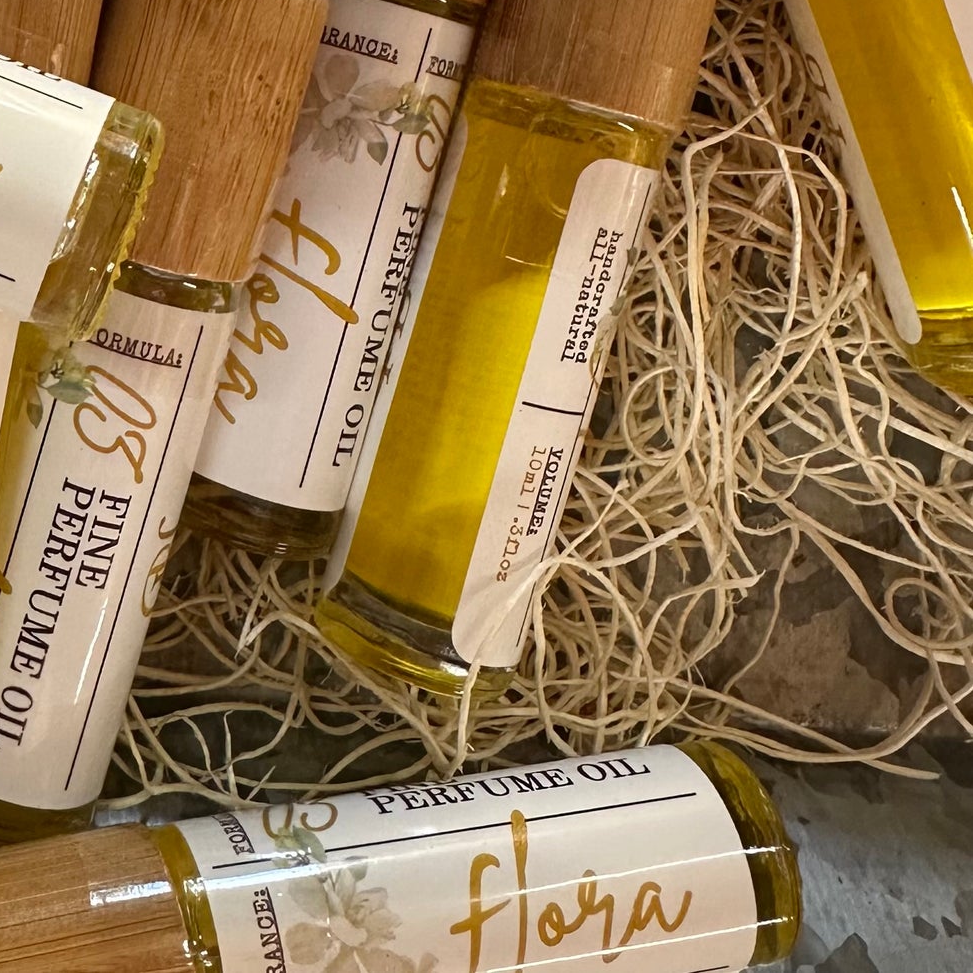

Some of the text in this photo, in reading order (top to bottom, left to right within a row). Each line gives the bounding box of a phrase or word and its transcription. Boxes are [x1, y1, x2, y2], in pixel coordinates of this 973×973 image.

[320, 25, 399, 66] RANCE:
[355, 201, 419, 392] PERFUME
[561, 226, 609, 363] all-natural
[575, 229, 625, 364] handcrafted
[91, 327, 184, 369] ORMULA:
[330, 402, 366, 469] OIL
[519, 444, 548, 504] 10ml
[526, 445, 565, 537] VOLUME:
[9, 476, 97, 680] PERFUME
[74, 490, 133, 590] FINE
[370, 767, 574, 815] PERFUME
[578, 755, 652, 784] OIL
[449, 808, 693, 973] flora
